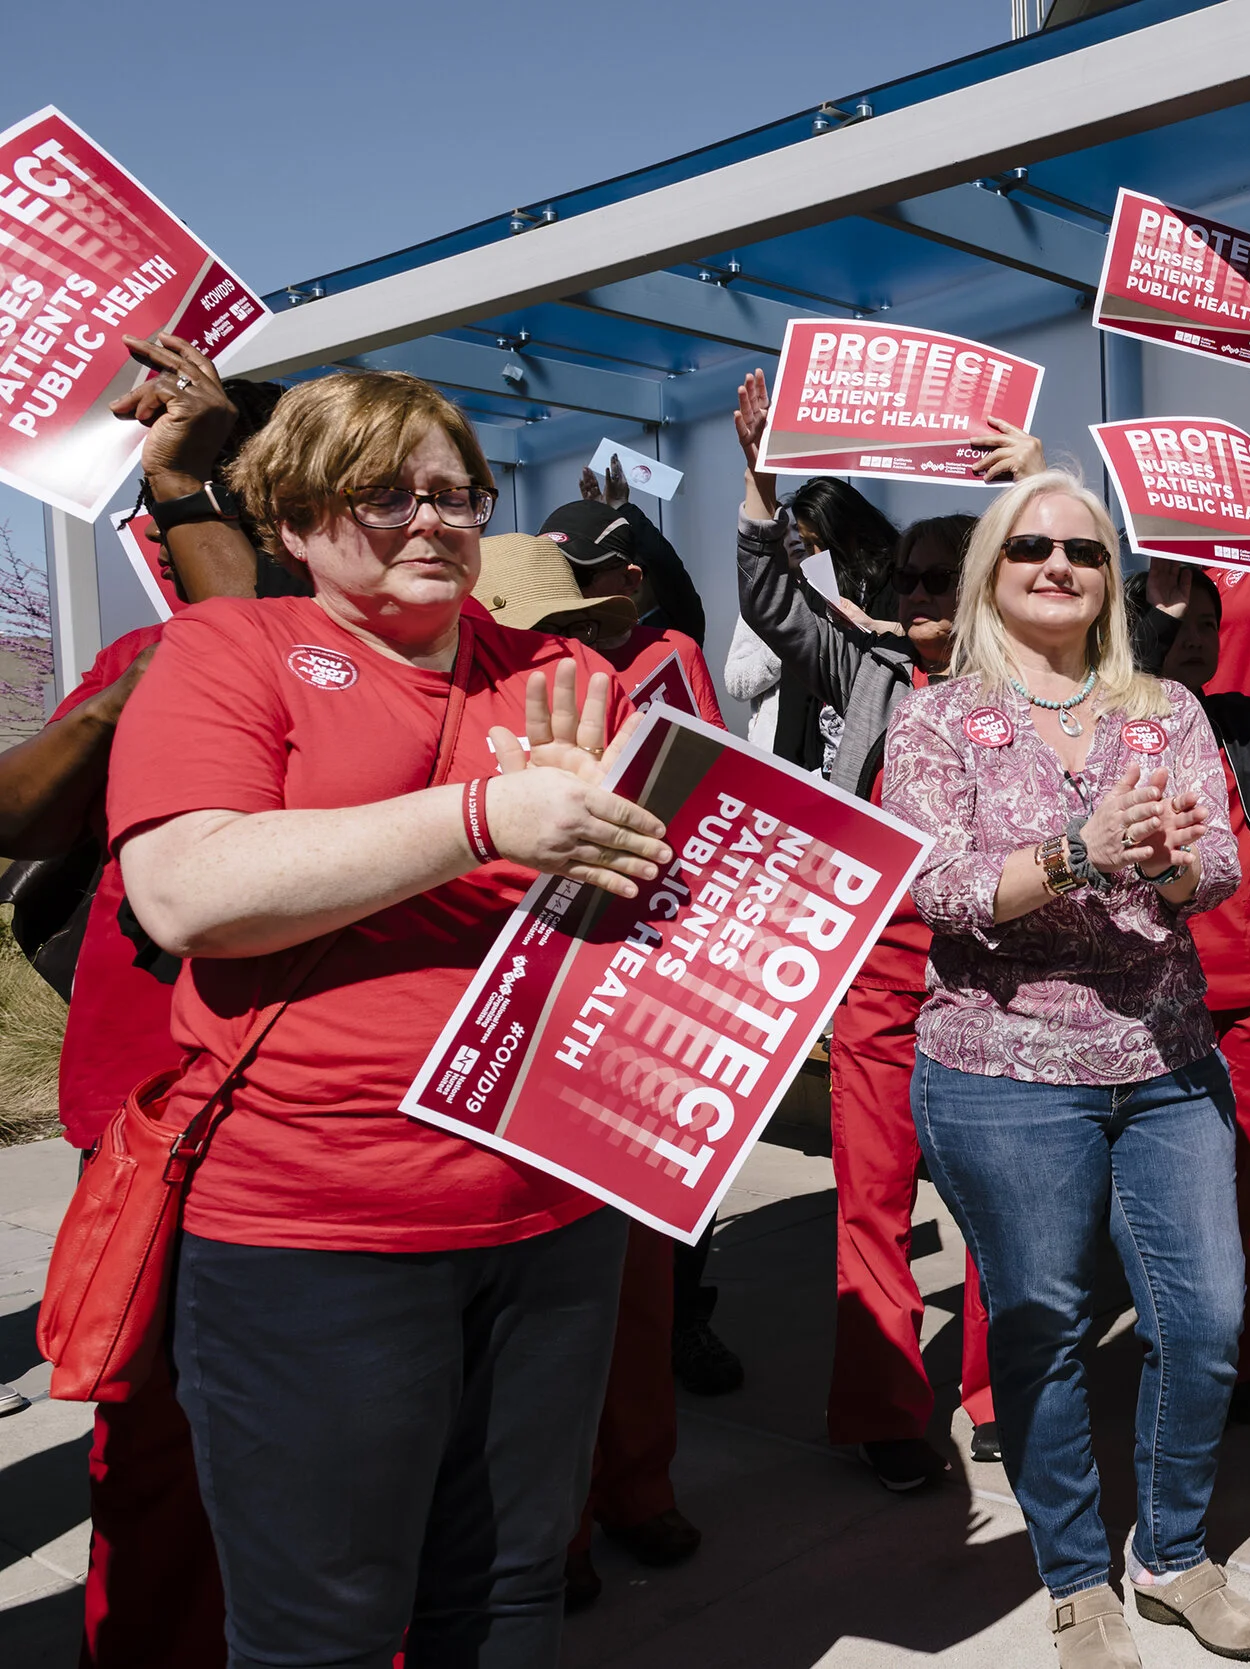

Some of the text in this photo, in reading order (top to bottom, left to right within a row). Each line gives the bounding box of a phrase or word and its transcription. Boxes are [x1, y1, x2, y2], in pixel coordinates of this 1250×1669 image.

[1133, 242, 1204, 273] NURSES
[1126, 275, 1190, 305] PUBLIC
[1129, 259, 1216, 294] PATIENTS
[200, 278, 236, 311] #COVID19
[0, 273, 97, 418] ATIENTS
[8, 254, 178, 438] PUBLIC HEALTH
[809, 332, 1013, 383] PROTECT
[805, 369, 891, 388] NURSES
[801, 388, 906, 407] PATIENTS
[797, 406, 969, 430] PUBLIC HEALTH
[1136, 459, 1215, 480] NURSES
[1143, 475, 1234, 500] PATIENTS
[1147, 491, 1216, 514] PUBLIC
[309, 654, 342, 669] YOU
[313, 664, 350, 677] NOT
[973, 713, 995, 725] YOU
[983, 720, 1004, 733] NOT
[1130, 726, 1150, 734] YOU
[1138, 732, 1158, 740] NOT
[469, 797, 481, 837] PROTECT
[655, 809, 772, 982] PATIENTS
[708, 820, 813, 971] NURSES
[538, 916, 561, 946] California
[555, 792, 740, 1069] PUBLIC HEALTH
[475, 991, 498, 1026] Committee
[480, 997, 511, 1044] National Nurses
[481, 994, 504, 1028] Organizing
[653, 849, 883, 1189] PROTECT
[436, 1070, 453, 1094] United
[466, 1021, 525, 1113] #COVID19
[441, 1072, 458, 1096] Nurses
[446, 1075, 467, 1104] National
